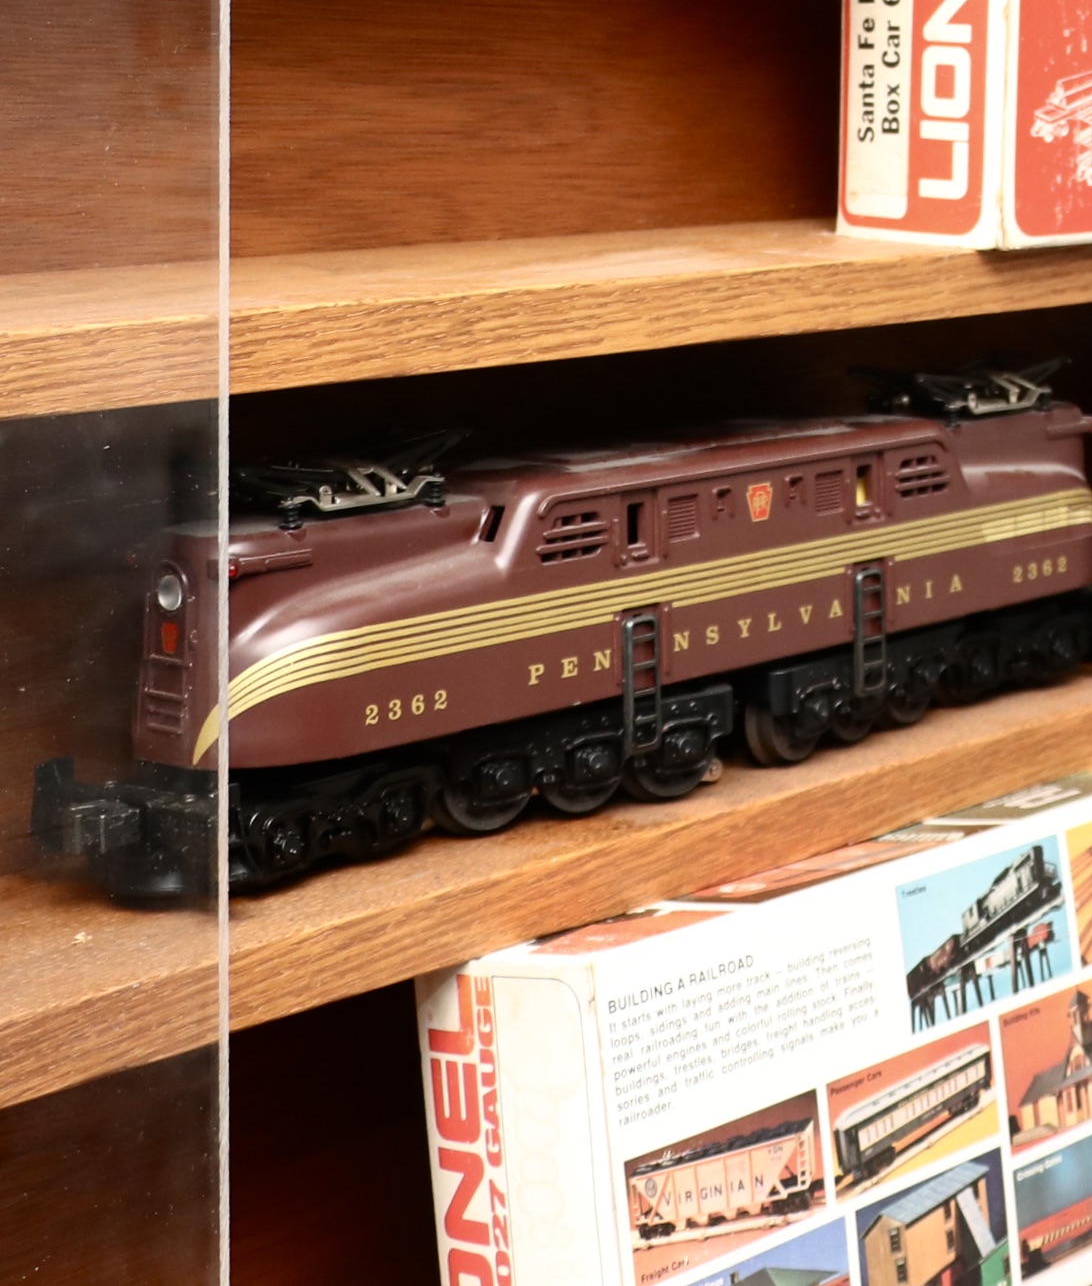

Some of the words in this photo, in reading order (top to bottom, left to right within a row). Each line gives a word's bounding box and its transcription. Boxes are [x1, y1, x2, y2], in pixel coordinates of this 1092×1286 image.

[857, 16, 876, 52] Fe
[882, 19, 901, 70] Car
[857, 62, 876, 144] Santa
[881, 82, 901, 137] Box
[363, 689, 449, 726] 2362
[527, 574, 966, 687] PENNSYLVANIA
[1012, 556, 1069, 584] 2362
[607, 977, 674, 1014] BUILDING
[677, 976, 686, 991] A
[689, 954, 755, 987] RAILROAD
[608, 1021, 617, 1035] It
[622, 1012, 652, 1029] starts
[656, 1002, 678, 1018] with
[681, 990, 713, 1014] laying
[716, 983, 742, 998] more
[746, 971, 771, 988] track
[787, 952, 826, 974] building
[829, 936, 872, 960] reversing
[612, 1050, 634, 1065] real
[640, 1028, 698, 1056] railroading
[704, 1018, 721, 1033] fun
[728, 1010, 748, 1025] with
[754, 1003, 769, 1015] the
[775, 987, 814, 1009] addition
[820, 981, 829, 993] of
[834, 970, 861, 988] trains
[649, 1018, 688, 1037] sidings
[693, 1007, 712, 1022] and
[717, 994, 752, 1015] adding
[756, 983, 781, 999] main
[816, 964, 839, 979] Then
[843, 951, 873, 969] comes
[614, 1055, 661, 1083] powerful
[666, 1040, 708, 1064] engines
[712, 1030, 731, 1047] and
[735, 1016, 773, 1038] colorful
[777, 1003, 808, 1024] rolling
[766, 1023, 798, 1043] freight
[802, 1005, 844, 1027] handling
[474, 975, 503, 1168] GAUGE
[616, 1094, 650, 1112] sories
[657, 1082, 678, 1099] and
[684, 1069, 715, 1088] traffic
[721, 1049, 775, 1076] controlling
[780, 1031, 815, 1054] signals
[820, 1021, 846, 1038] make
[851, 1011, 869, 1028] you
[874, 1008, 880, 1018] a
[829, 1077, 865, 1097] Passenger
[866, 1070, 883, 1083] Cars
[663, 1174, 765, 1207] VIRGINIAN
[640, 1266, 670, 1284] Freight
